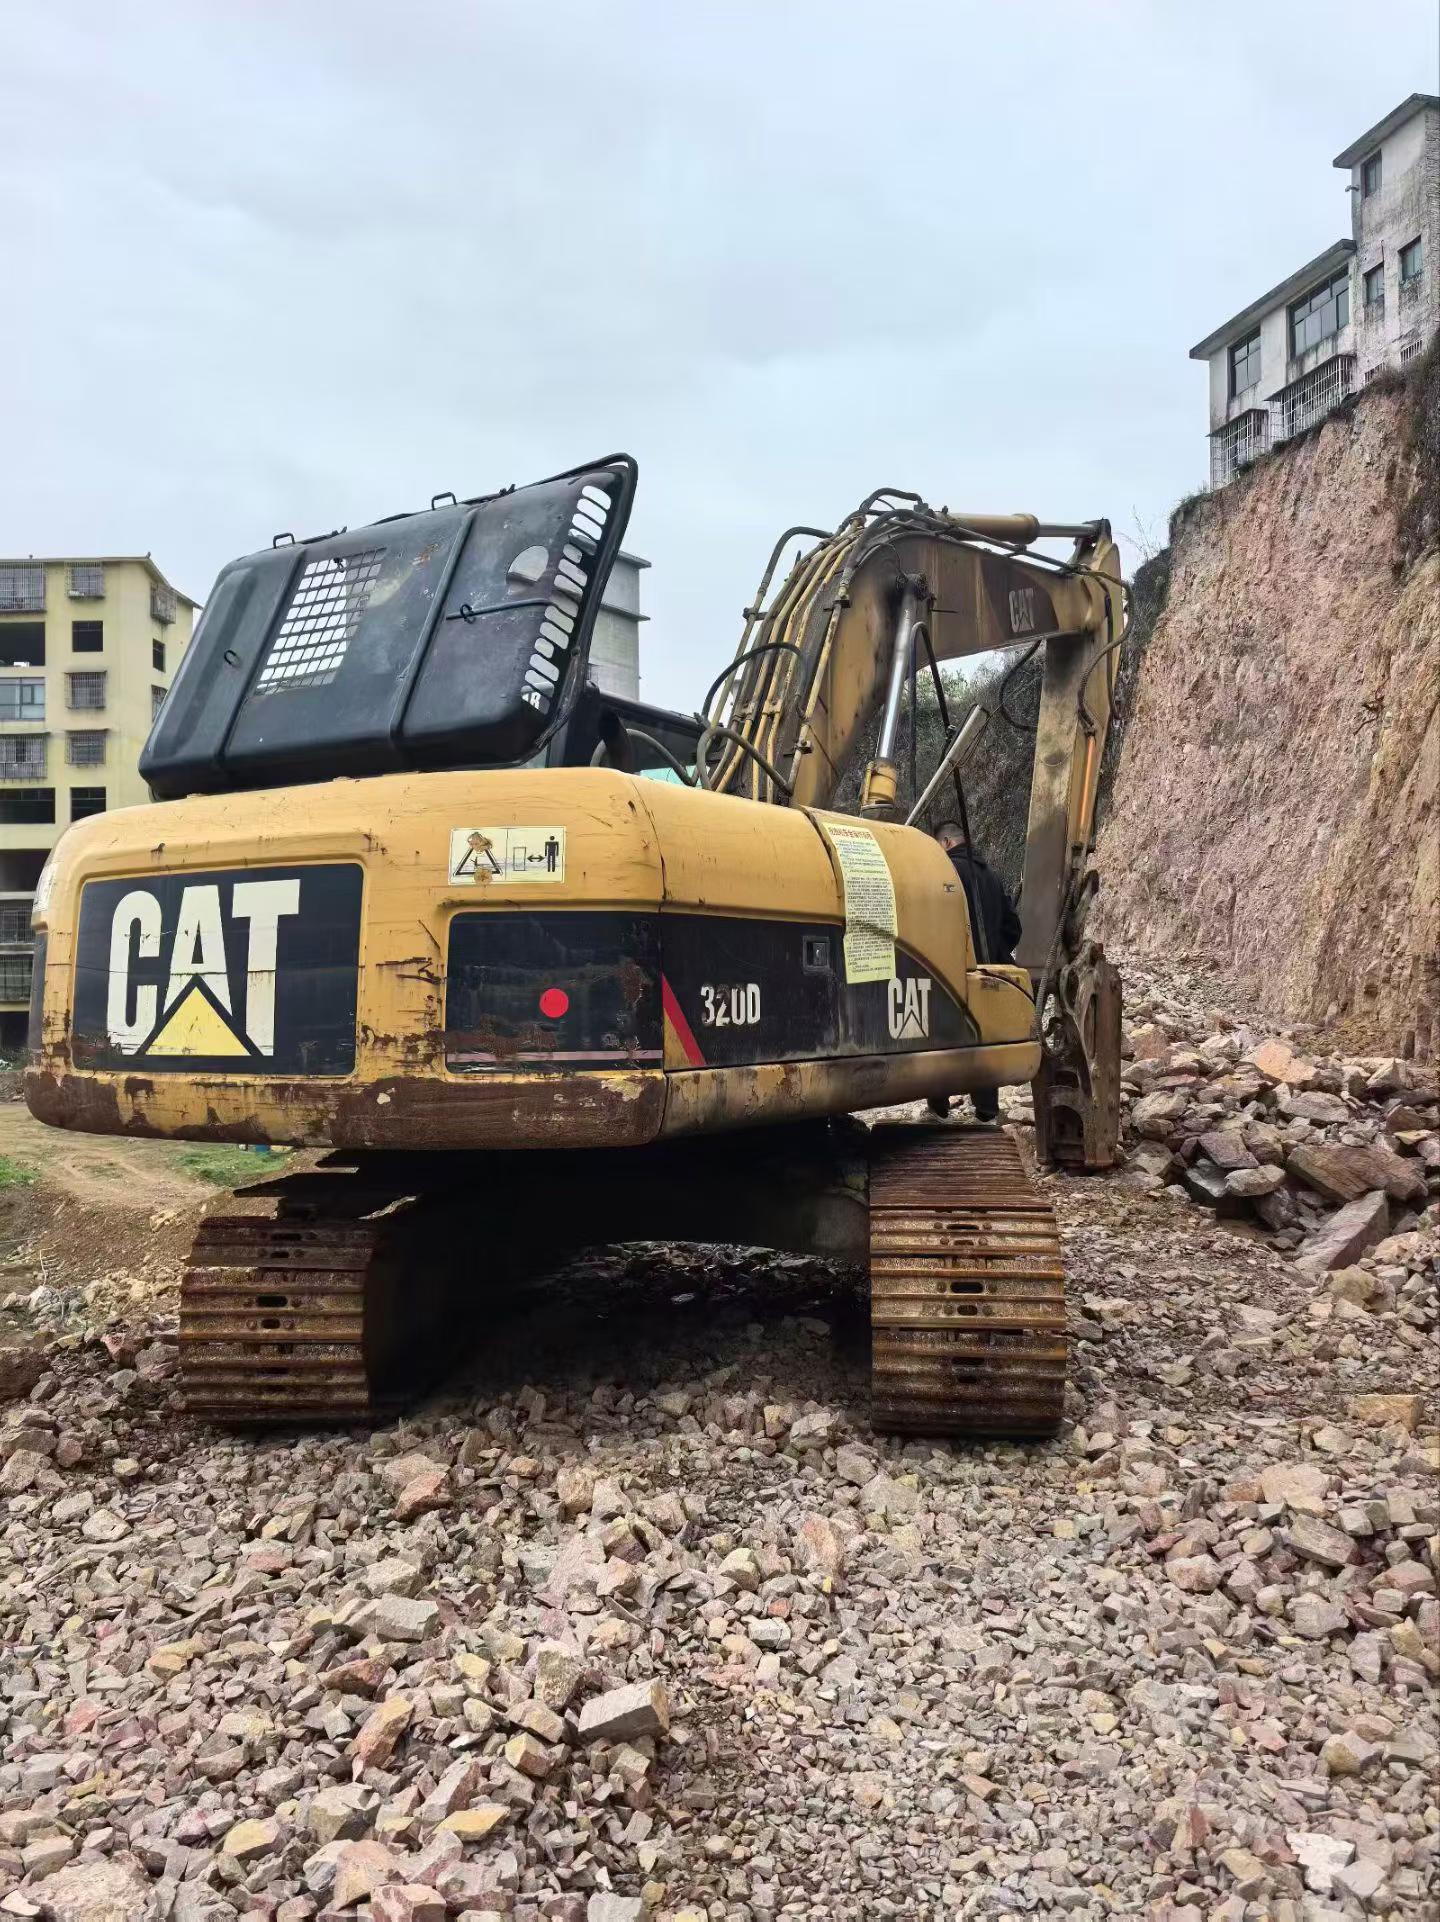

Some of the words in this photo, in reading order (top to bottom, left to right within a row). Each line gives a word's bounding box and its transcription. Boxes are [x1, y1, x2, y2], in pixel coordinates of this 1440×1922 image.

[1008, 588, 1035, 633] CAT
[107, 879, 301, 1056] CAT
[700, 983, 761, 1027] 320D
[887, 977, 932, 1040] CAT
